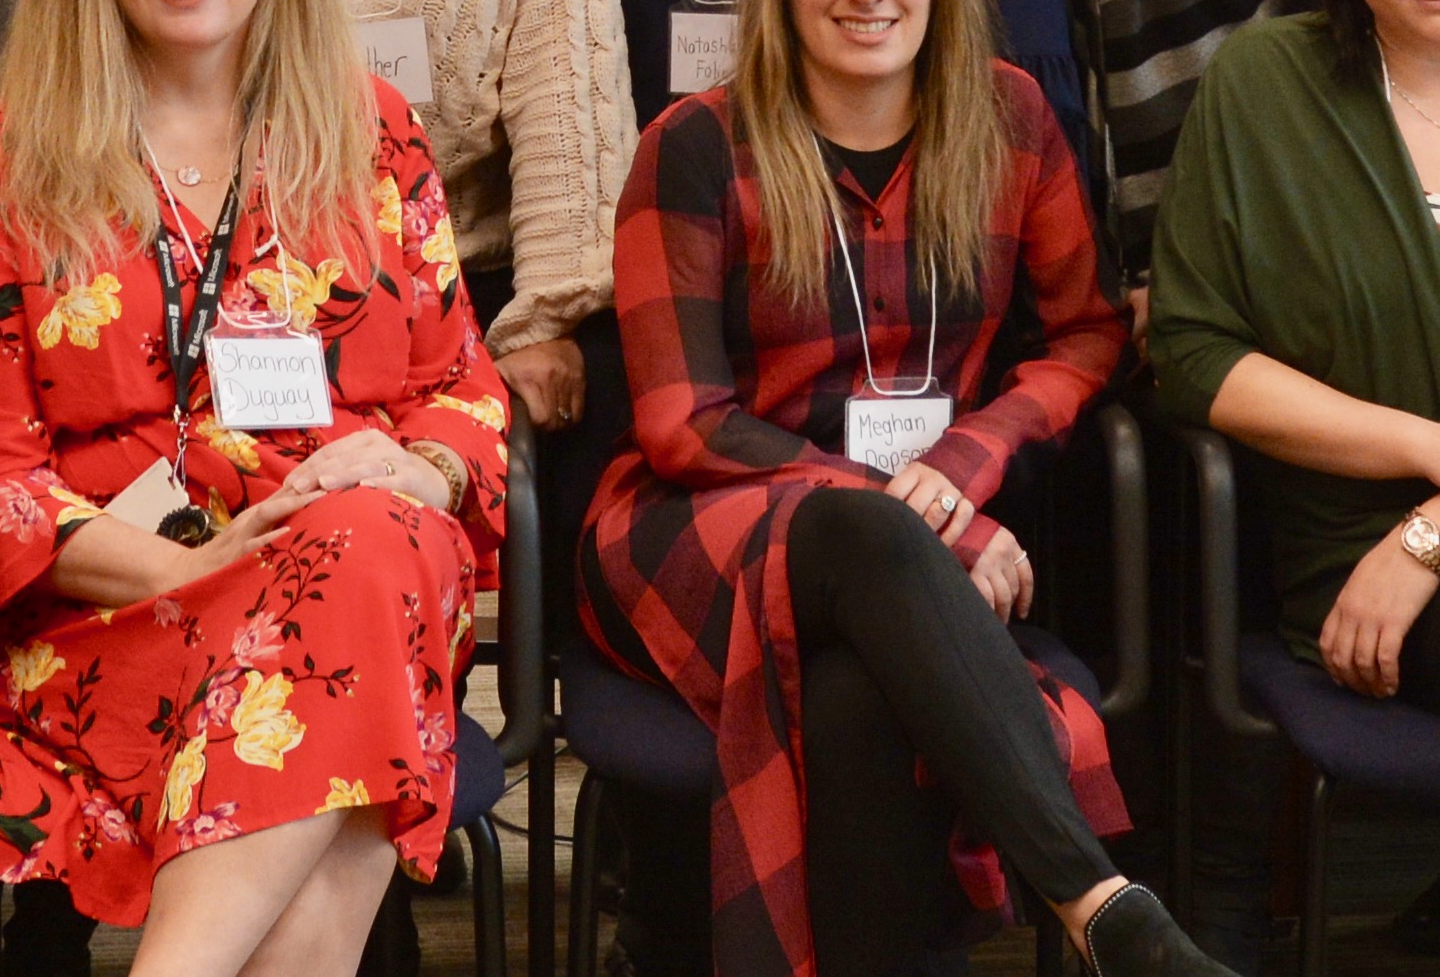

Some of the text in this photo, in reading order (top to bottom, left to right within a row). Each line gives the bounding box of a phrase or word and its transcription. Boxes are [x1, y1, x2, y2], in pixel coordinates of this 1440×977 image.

[218, 342, 317, 377] Shannon
[222, 378, 316, 422] Duguay
[858, 412, 927, 447] Meghan
